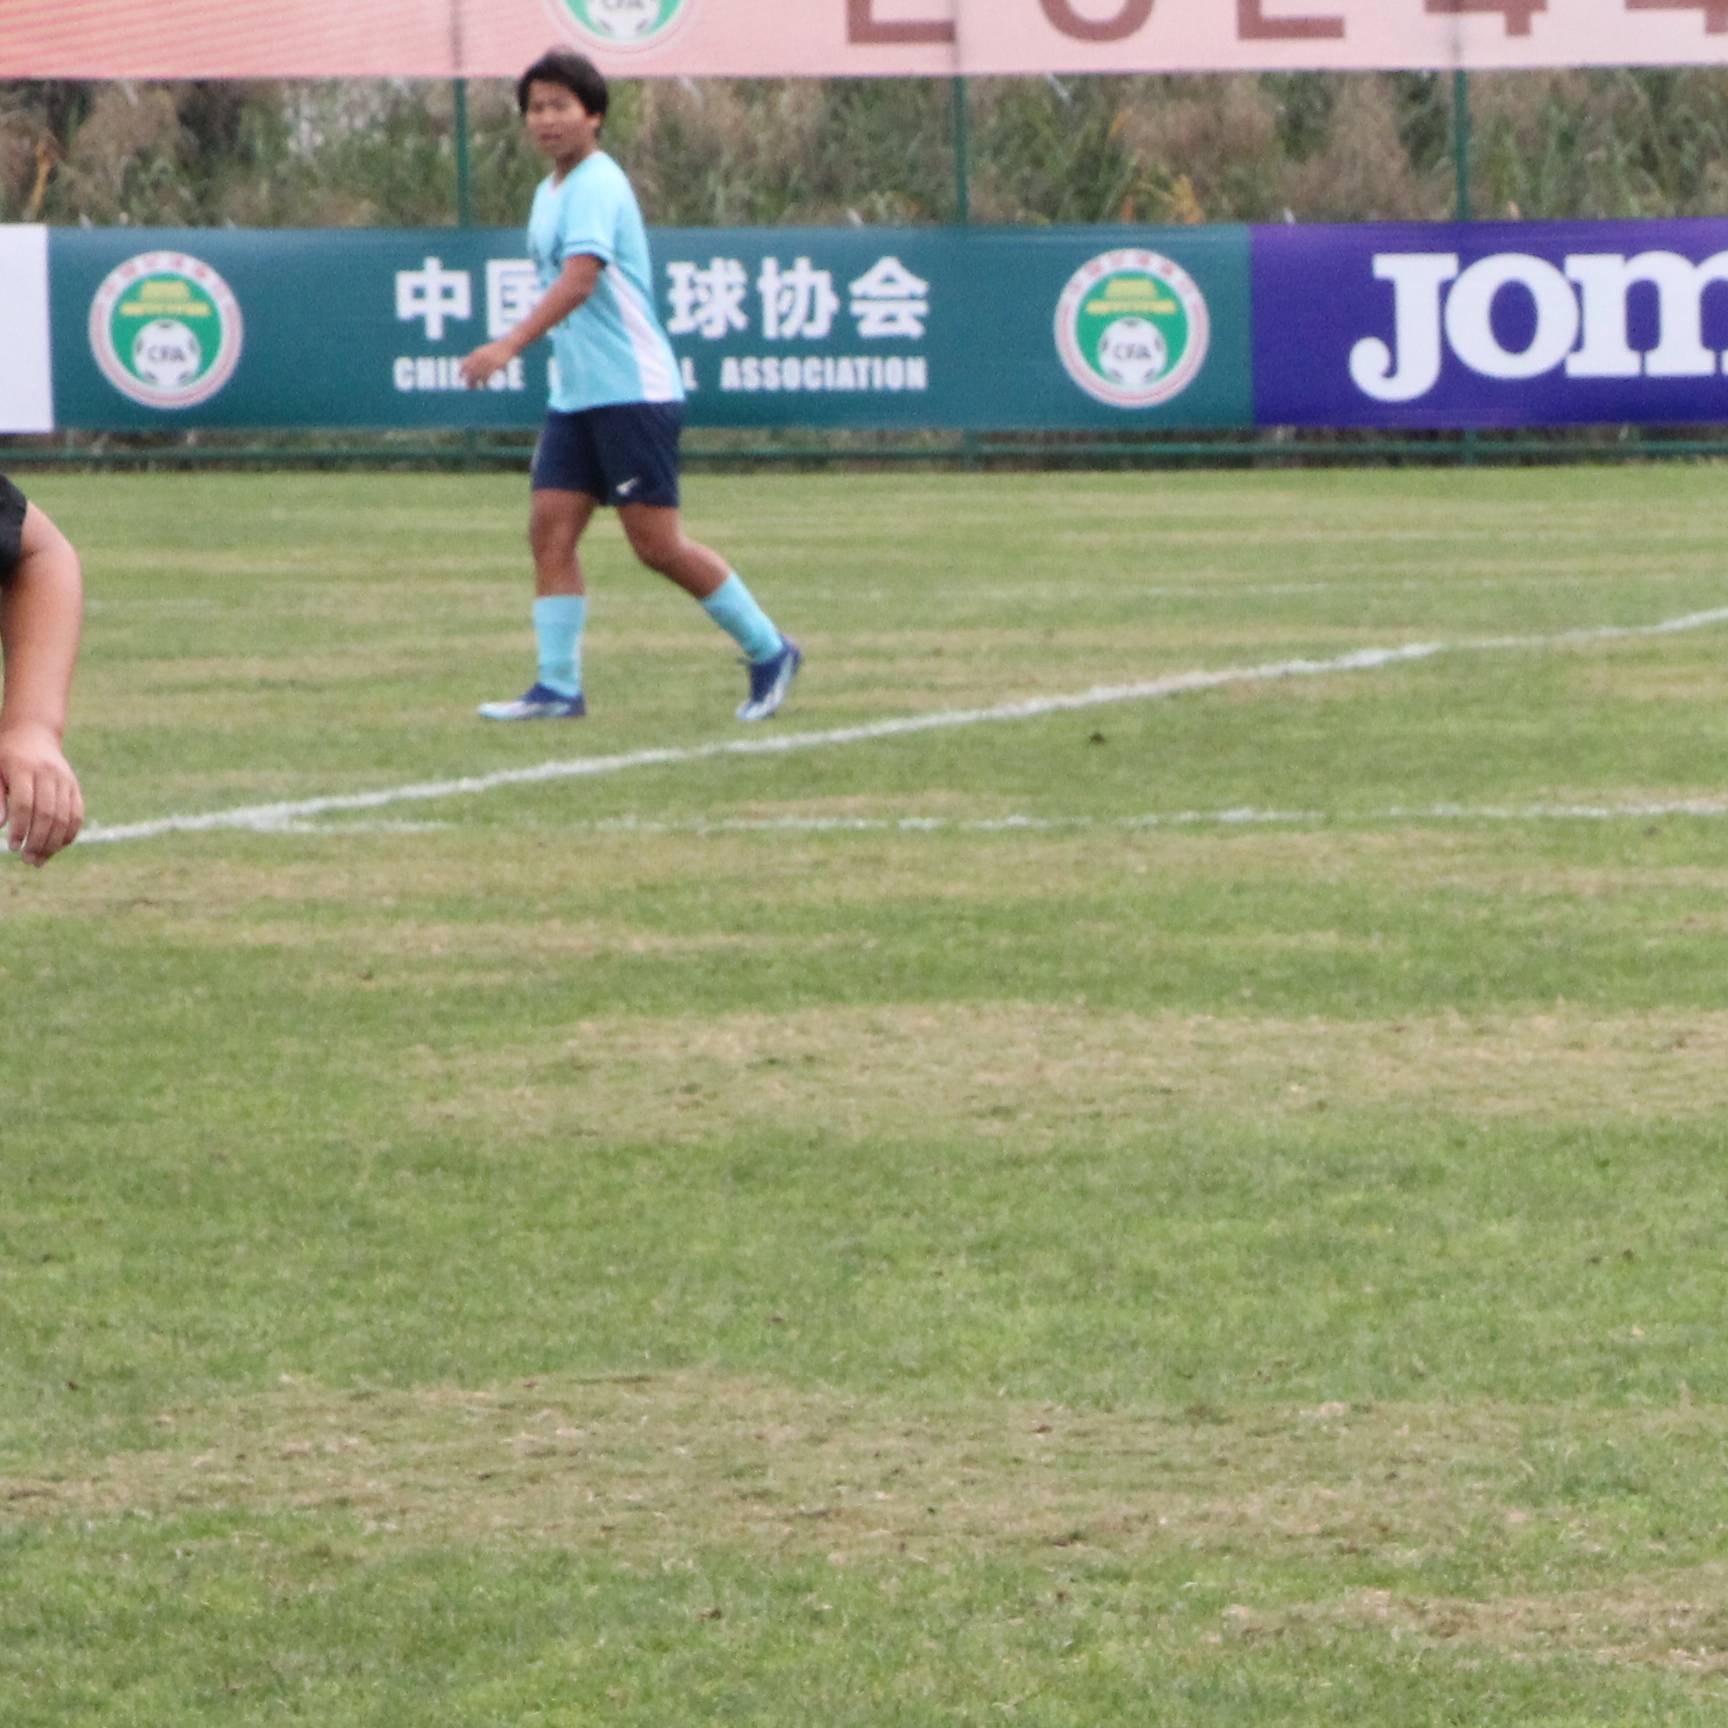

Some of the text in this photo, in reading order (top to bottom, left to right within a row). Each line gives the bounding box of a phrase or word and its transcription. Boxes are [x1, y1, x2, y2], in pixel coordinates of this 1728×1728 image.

[396, 256, 930, 340] 中国球协会
[720, 356, 928, 391] ASSOCIATION
